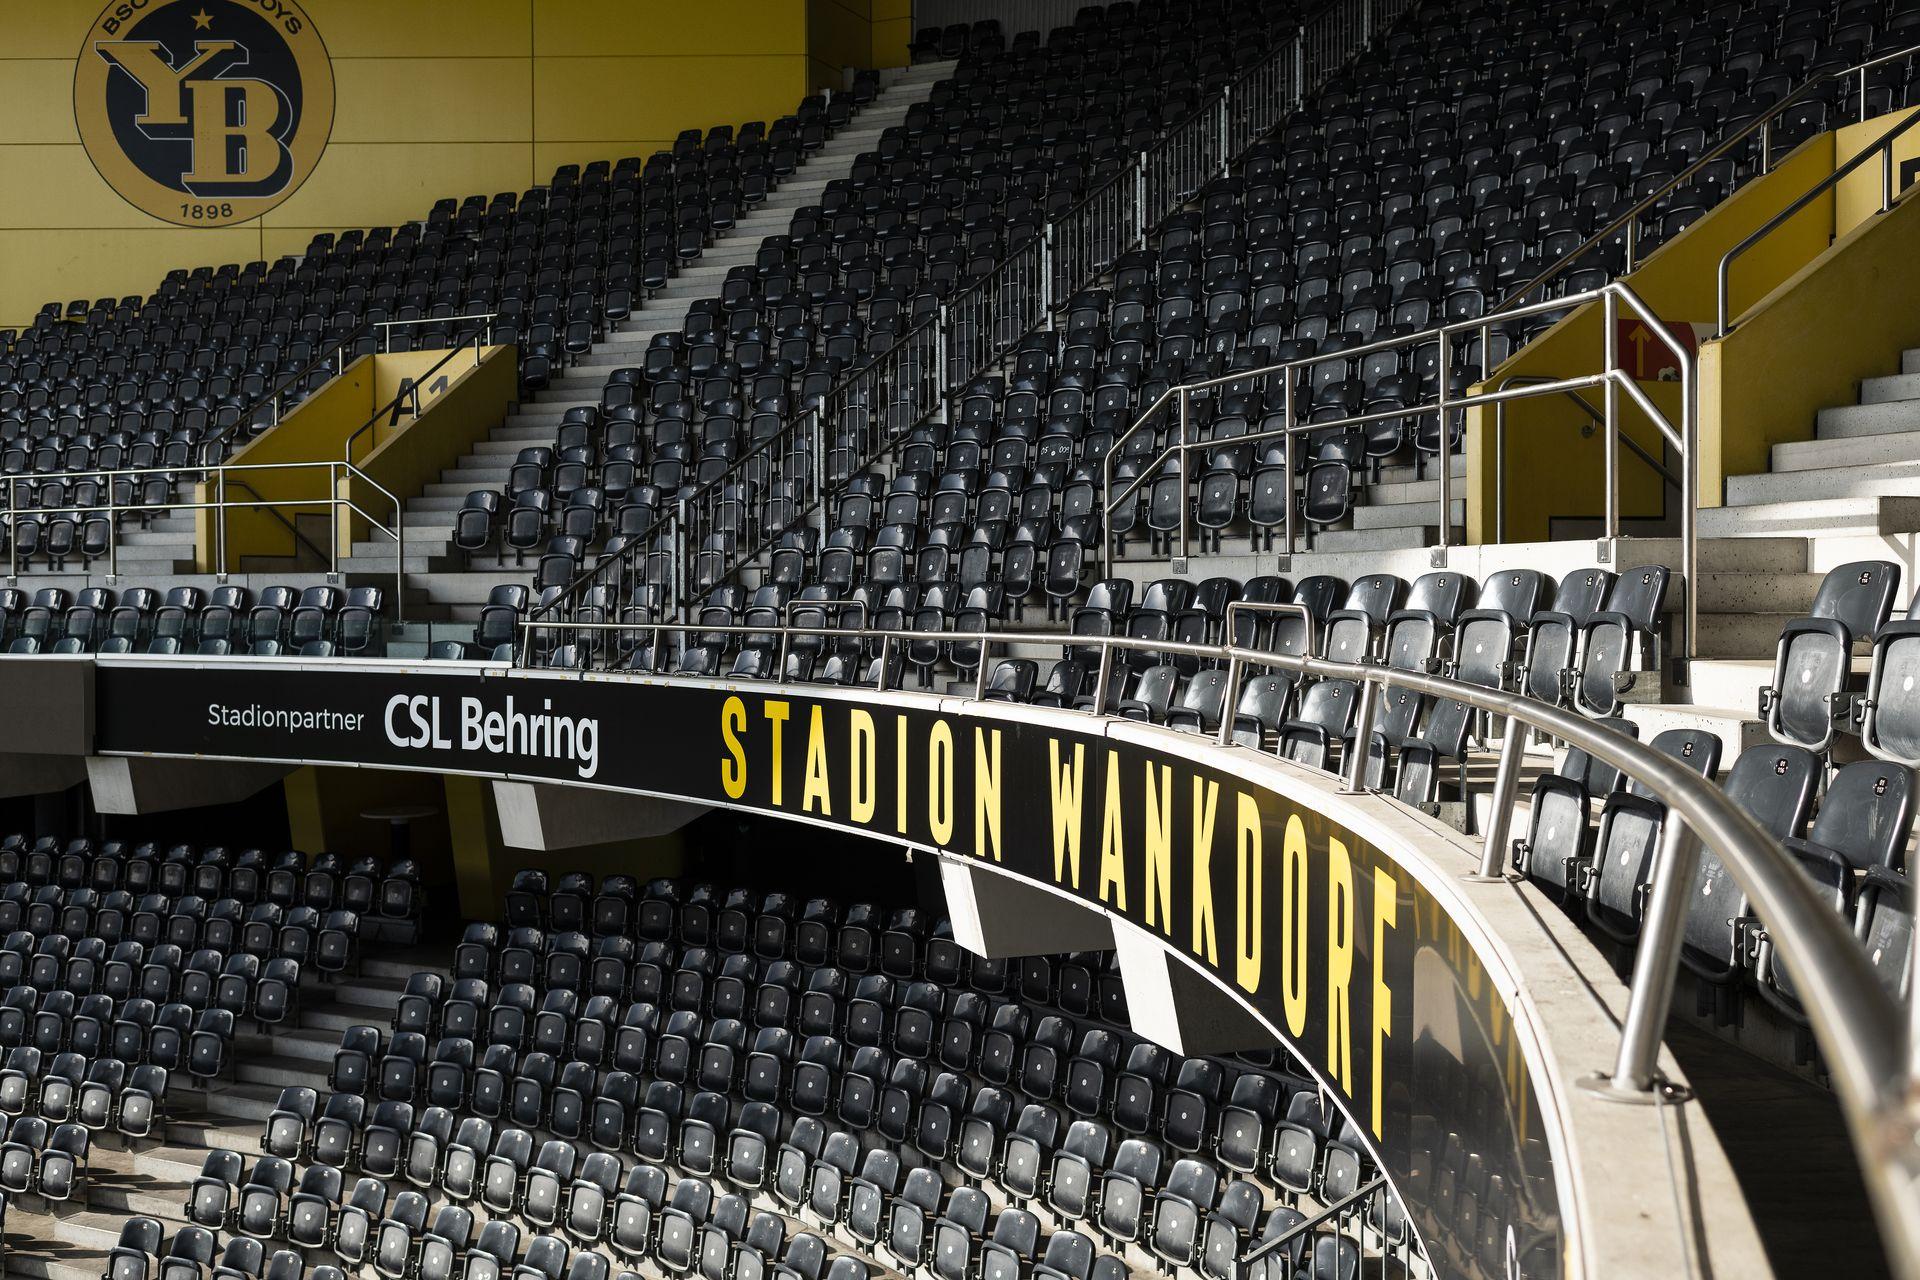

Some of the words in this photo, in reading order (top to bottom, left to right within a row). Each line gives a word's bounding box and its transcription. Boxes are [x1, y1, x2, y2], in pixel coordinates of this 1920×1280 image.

[250, 0, 302, 34] OYS
[181, 203, 233, 219] 1898
[208, 704, 365, 733] Stadionpartner
[384, 694, 452, 750] CSL
[461, 695, 599, 779] Behring
[722, 696, 1001, 861] STADION
[1050, 739, 1397, 1142] WANKDORF
